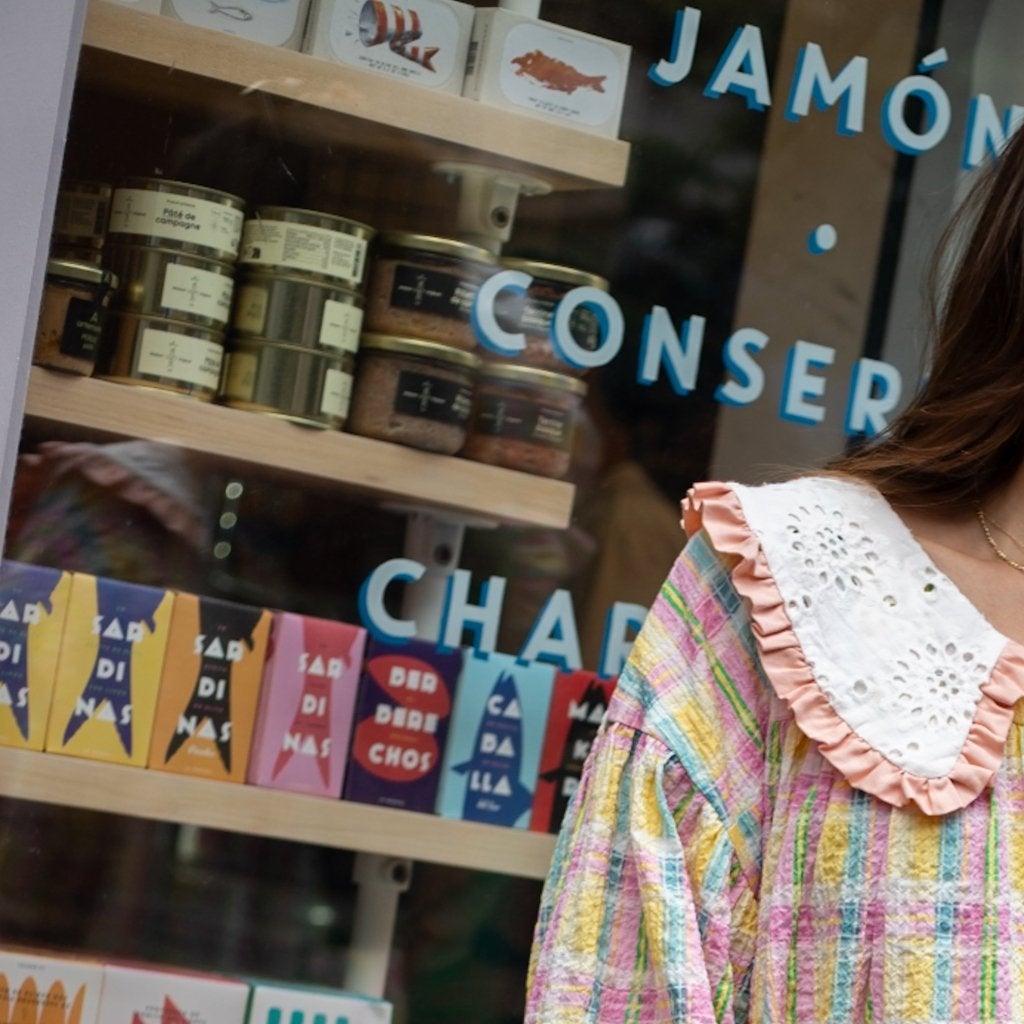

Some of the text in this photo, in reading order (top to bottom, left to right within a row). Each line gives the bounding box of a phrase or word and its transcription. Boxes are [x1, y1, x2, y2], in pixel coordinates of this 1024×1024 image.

[471, 269, 902, 437] CONSER
[0, 600, 41, 625] AR
[92, 615, 144, 643] SAR
[194, 634, 244, 662] SAR
[96, 658, 126, 682] DI
[297, 652, 343, 680] SAR
[389, 665, 439, 694] BER
[0, 682, 29, 708] AS
[197, 676, 226, 701] DI
[75, 696, 132, 725] NAS
[301, 694, 328, 716] DI
[374, 703, 439, 734] BERE
[487, 694, 522, 719] CA
[176, 713, 231, 743] NAS
[282, 732, 332, 758] NAS
[368, 742, 431, 773] CHOS
[479, 732, 515, 757] BA
[470, 769, 512, 796] LLA
